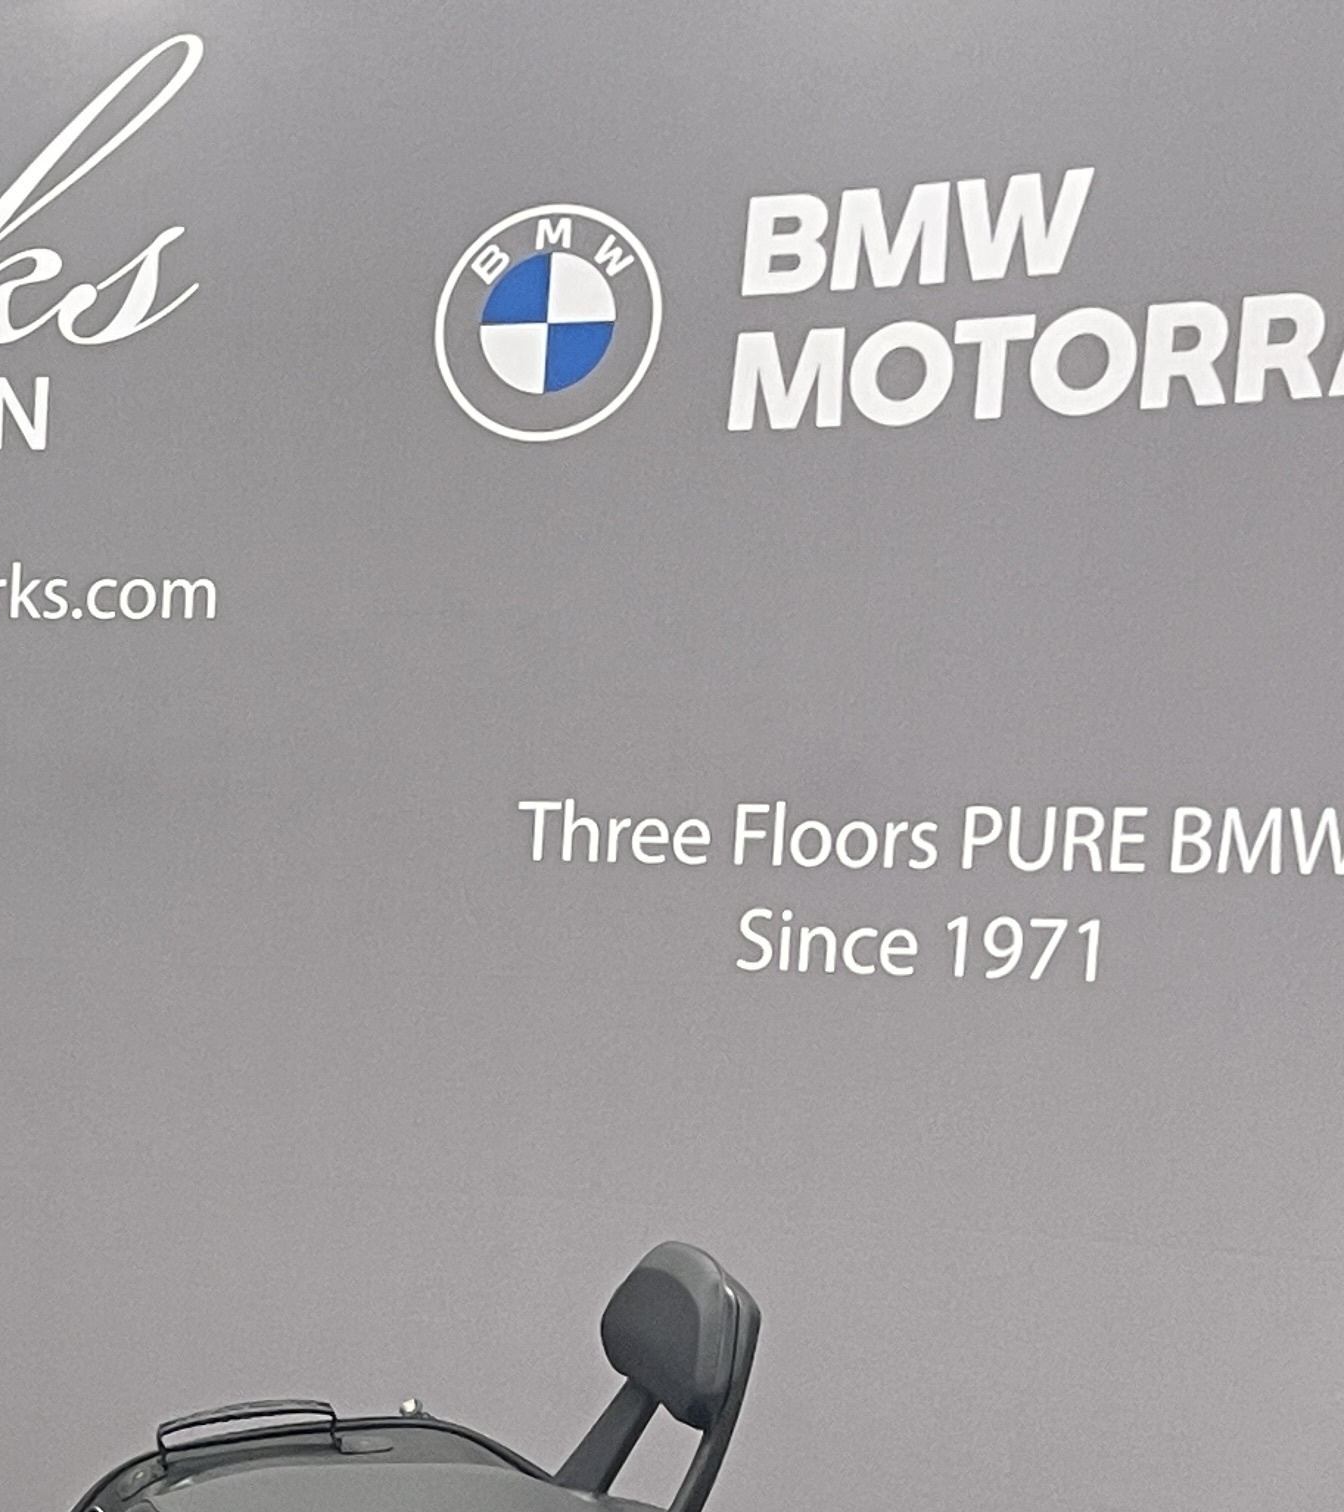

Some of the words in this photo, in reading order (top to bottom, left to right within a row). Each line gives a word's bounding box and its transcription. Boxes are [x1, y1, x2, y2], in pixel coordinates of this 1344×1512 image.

[472, 218, 634, 284] BMW
[742, 168, 1094, 296] BMW
[728, 293, 1344, 430] MOTORR
[519, 799, 710, 864] Three
[734, 802, 937, 869] Floors
[963, 806, 1147, 872] PURE
[1171, 807, 1344, 874] BMW
[737, 909, 917, 975] Since
[948, 917, 1099, 981] 1971
